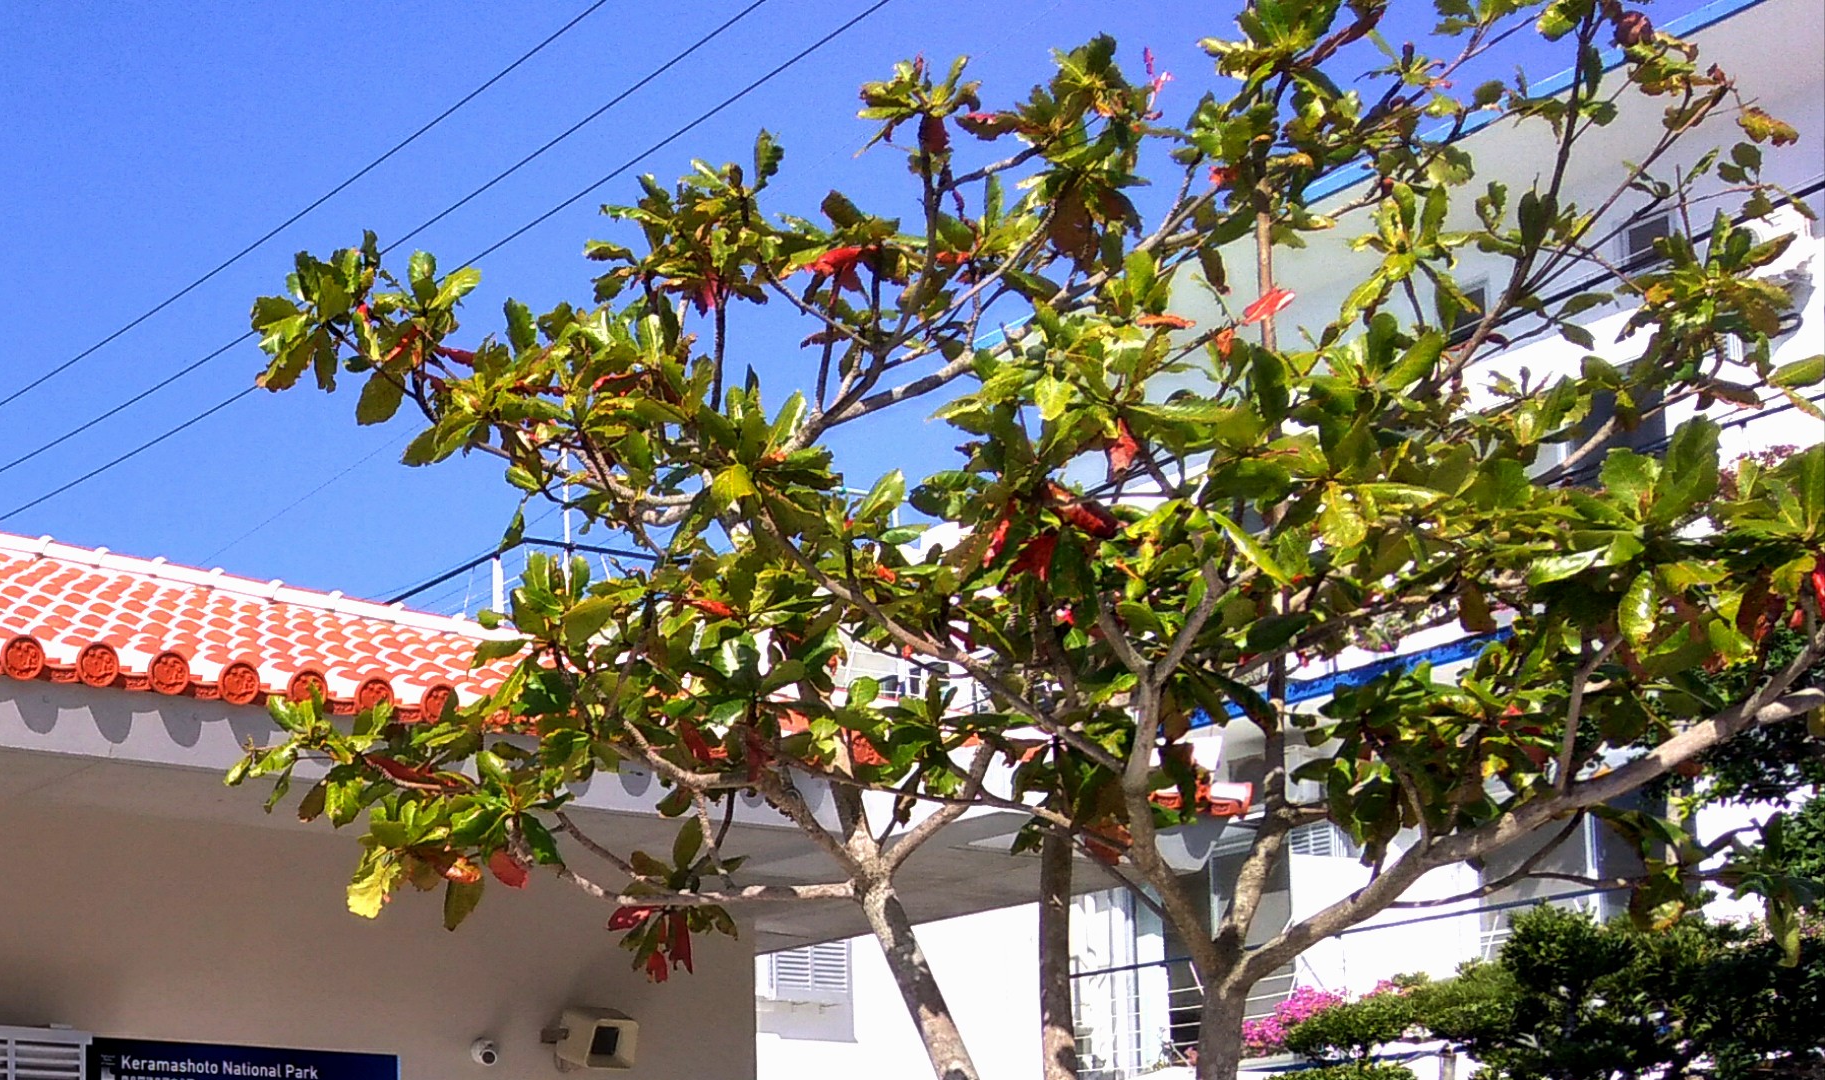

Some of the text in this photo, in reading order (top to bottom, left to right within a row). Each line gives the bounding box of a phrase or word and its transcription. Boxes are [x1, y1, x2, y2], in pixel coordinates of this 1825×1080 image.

[120, 1055, 219, 1075] Keramashoto
[222, 1060, 282, 1079] National
[285, 1064, 319, 1080] Park
